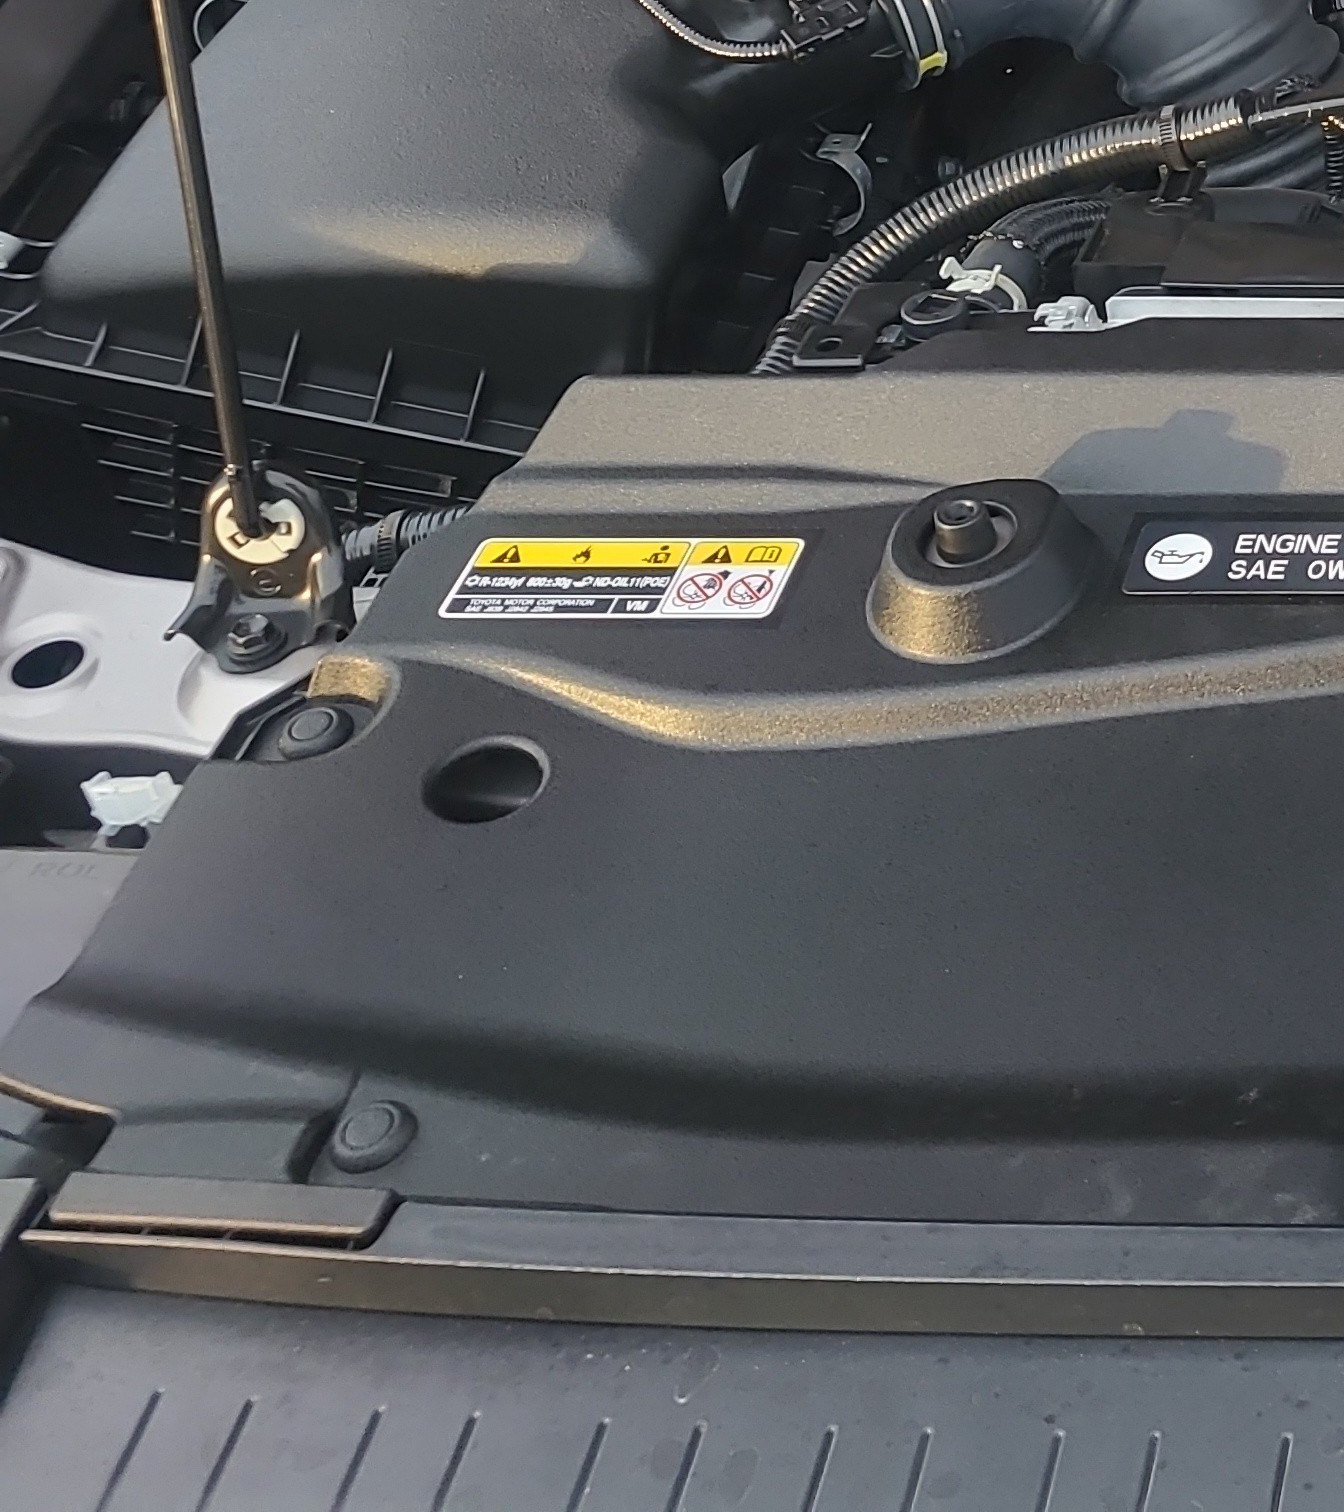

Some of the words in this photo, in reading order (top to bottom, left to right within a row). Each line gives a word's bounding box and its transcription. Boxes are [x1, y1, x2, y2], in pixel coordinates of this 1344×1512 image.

[1234, 533, 1343, 555] ENGINE
[1227, 558, 1290, 581] SAE
[469, 598, 503, 606] TOYOTA
[503, 598, 535, 606] MOTOR
[536, 598, 596, 607] CORPORATION
[626, 600, 650, 612] VM
